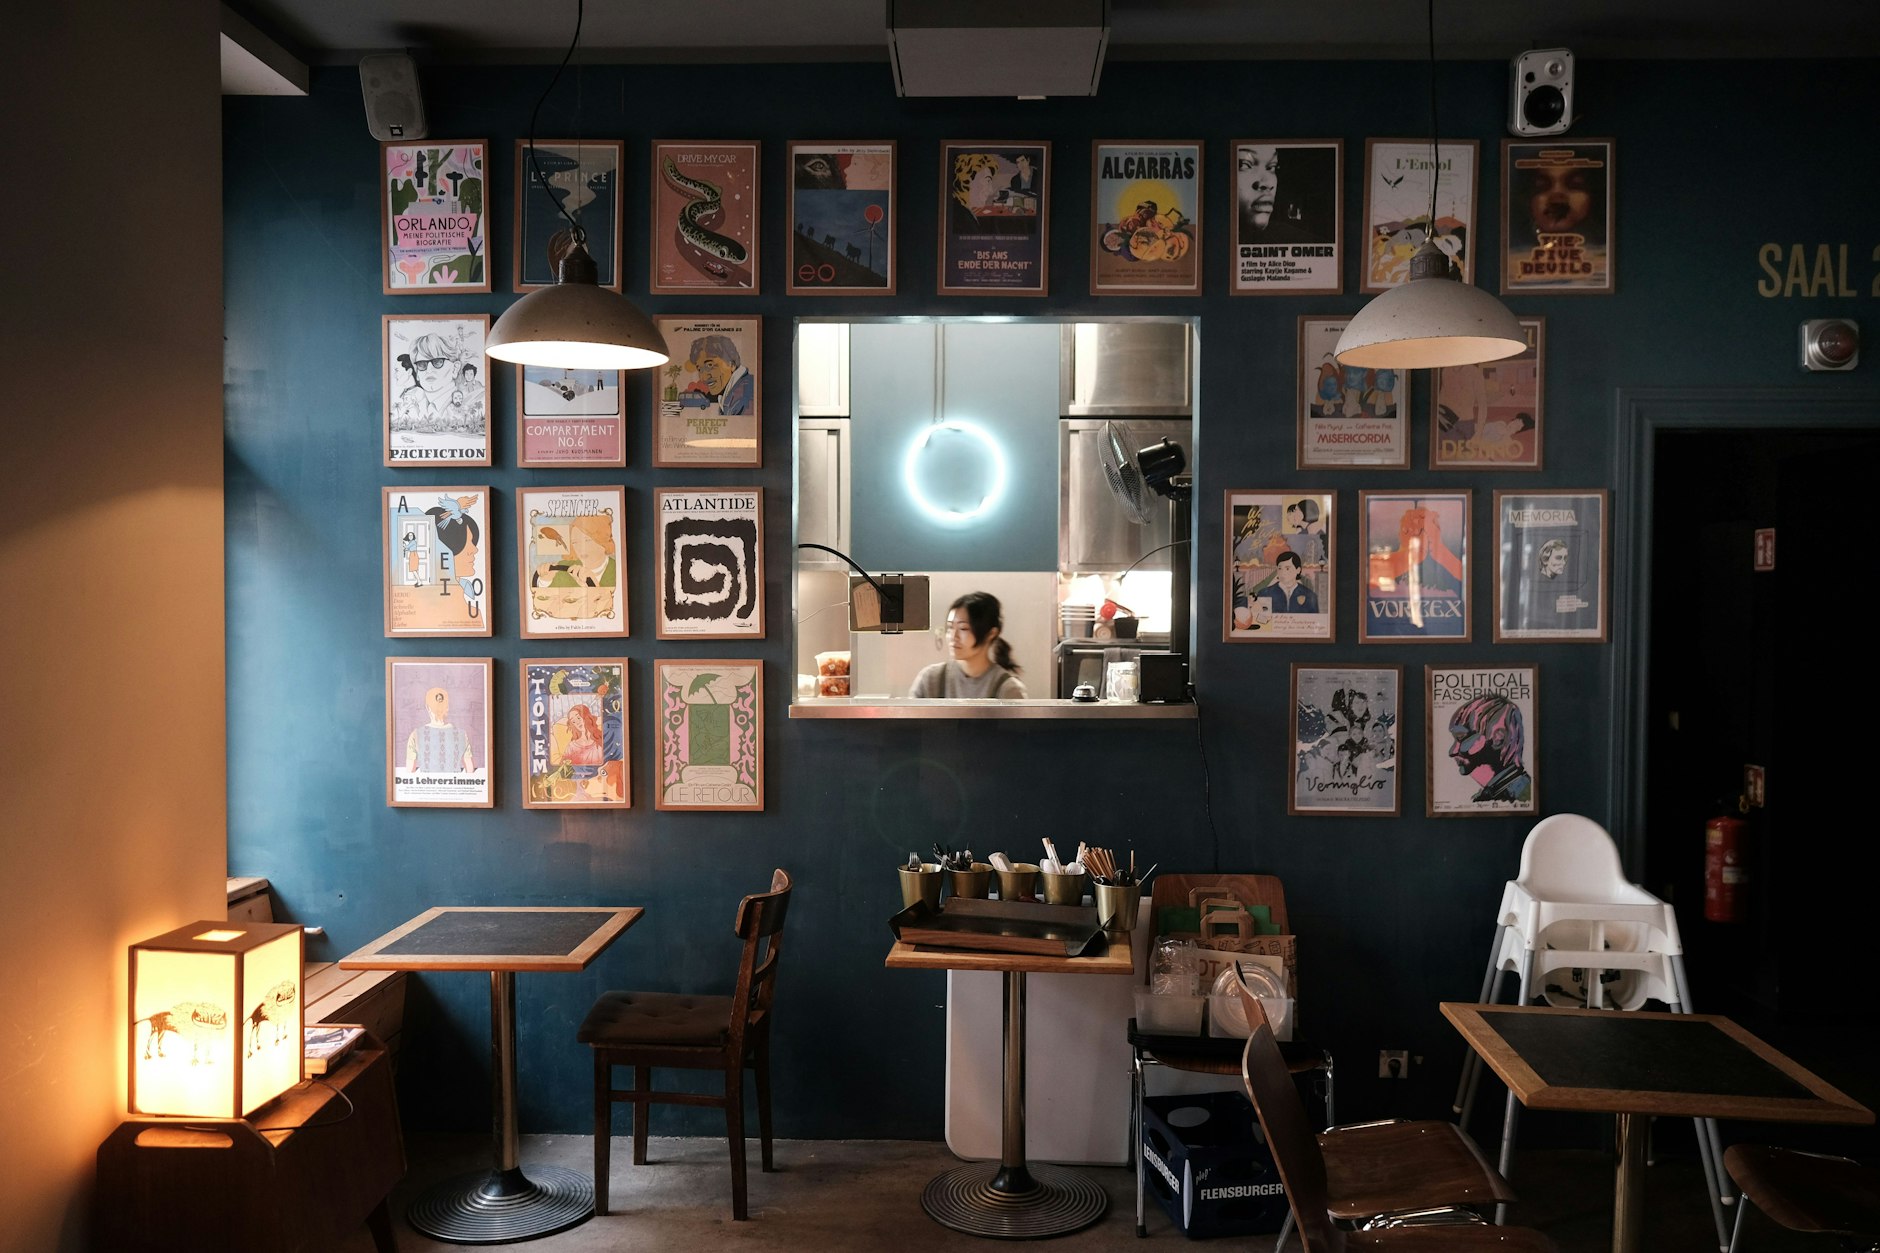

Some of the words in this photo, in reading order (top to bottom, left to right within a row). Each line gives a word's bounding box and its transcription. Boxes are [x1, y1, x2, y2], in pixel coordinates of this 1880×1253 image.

[677, 154, 703, 164] DRIVE
[704, 154, 718, 164] MY
[718, 154, 737, 164] CAR
[1102, 152, 1195, 179] ALCARRÀS
[554, 171, 608, 183] PRINCE
[398, 217, 473, 232] ORLANDO,
[425, 231, 466, 239] POLITISCHE
[416, 239, 452, 247] BIOGRAFIE
[992, 250, 1009, 260] ANS
[1534, 249, 1582, 261] FIVE
[958, 260, 981, 270] ENDE
[983, 260, 1000, 270] DER
[1260, 261, 1266, 269] by
[1522, 261, 1592, 275] DEVILS
[1757, 243, 1858, 298] SAAL
[686, 418, 728, 428] PERFECT
[526, 425, 615, 436] COMPARTMENT
[695, 427, 720, 436] DAYS
[1317, 432, 1392, 444] MISERICORDIA
[389, 449, 486, 460] PACIFICTION
[545, 499, 600, 518] SPENCER
[662, 498, 756, 511] ATLANTIDE
[1510, 510, 1576, 522] MEMORIA
[1434, 672, 1530, 689] POLITICAL
[1433, 687, 1531, 701] FASSBINDER
[395, 777, 415, 786] Das
[416, 776, 487, 786] Lehrerzimmer
[1305, 775, 1387, 796] Vermiglio
[670, 787, 689, 803] LE
[693, 786, 751, 804] RETOUR
[1200, 1182, 1284, 1201] FLENSBURGER
